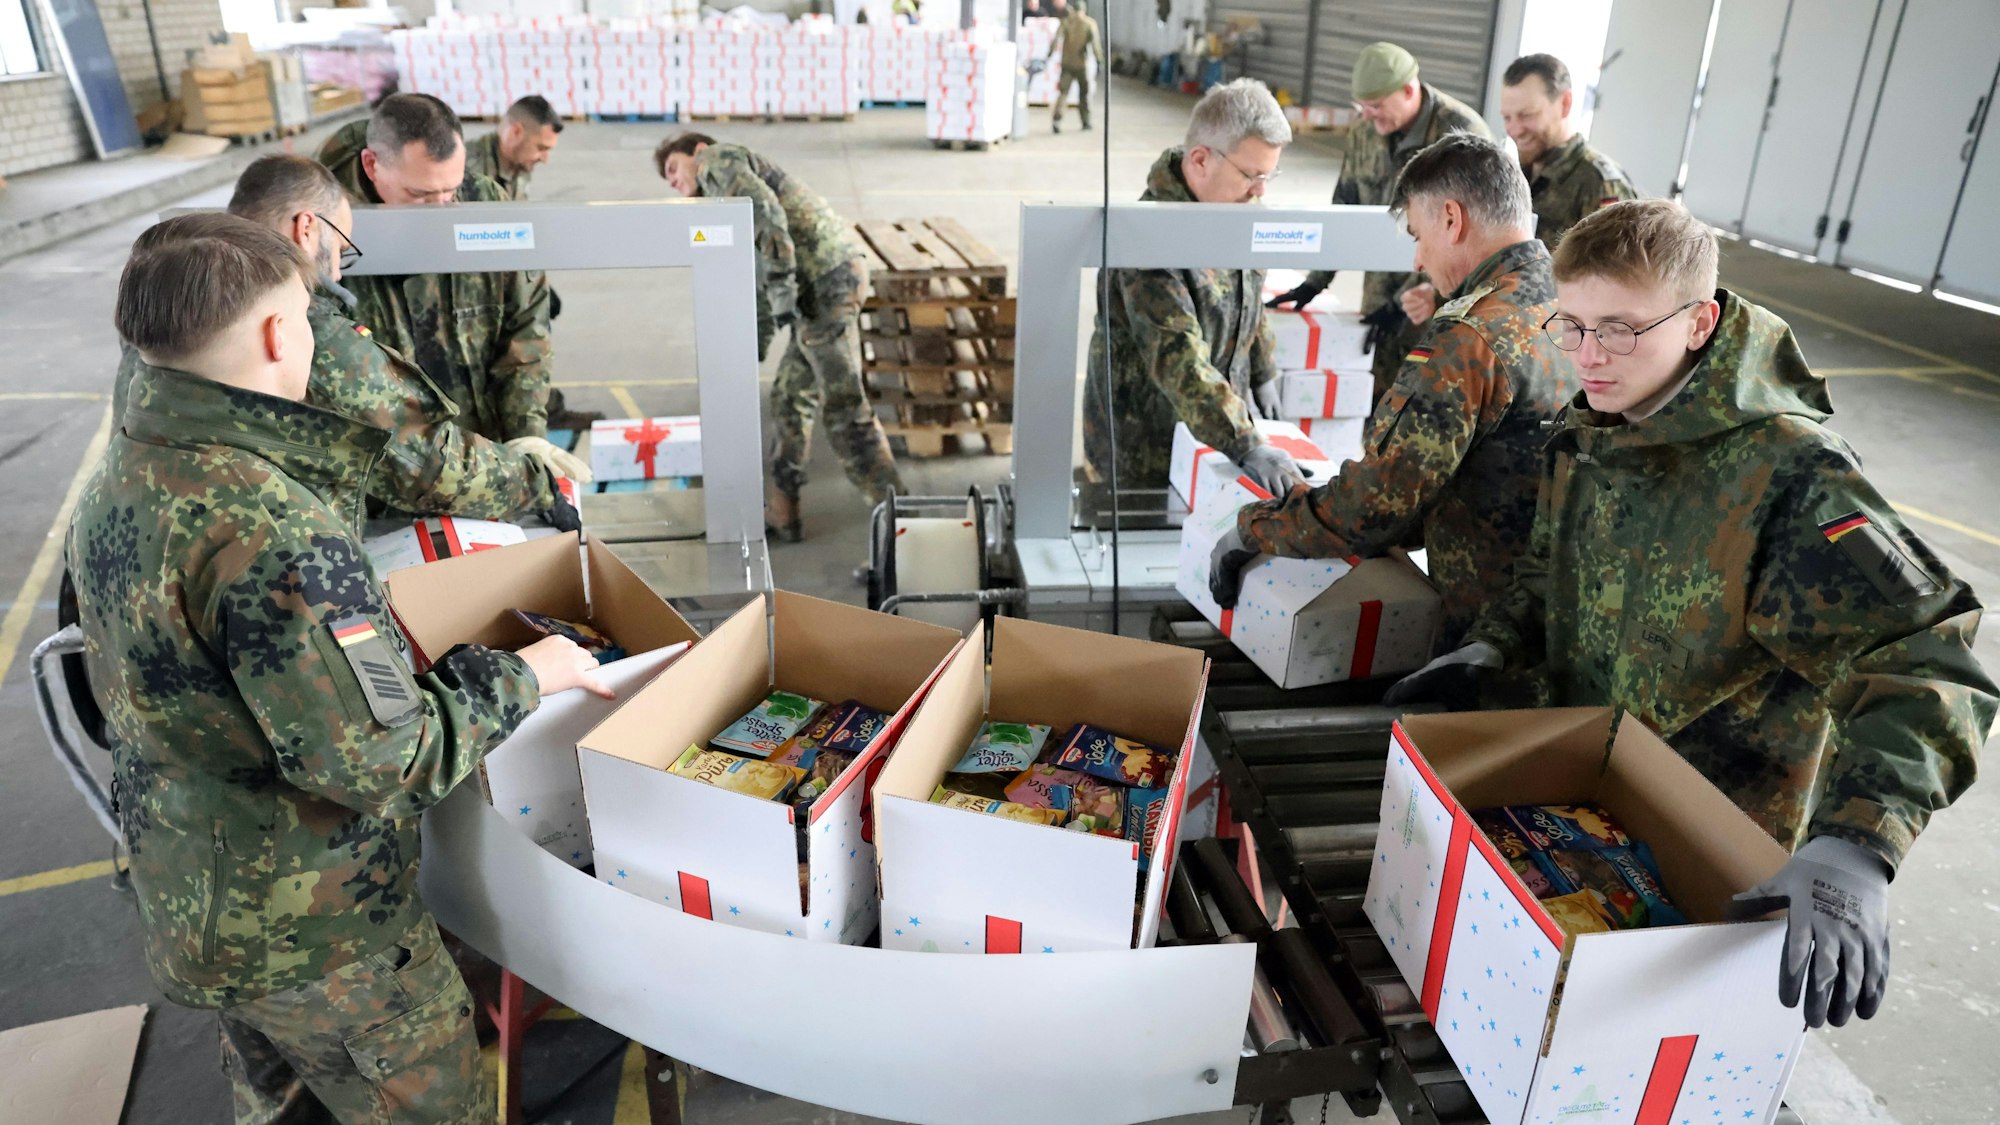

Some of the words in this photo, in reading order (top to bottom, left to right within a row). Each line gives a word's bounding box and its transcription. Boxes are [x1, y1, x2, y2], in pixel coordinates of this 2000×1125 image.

[459, 230, 511, 240] humboldt
[1255, 230, 1304, 240] humboldt
[741, 715, 785, 736] Speise
[742, 725, 787, 742] Götter
